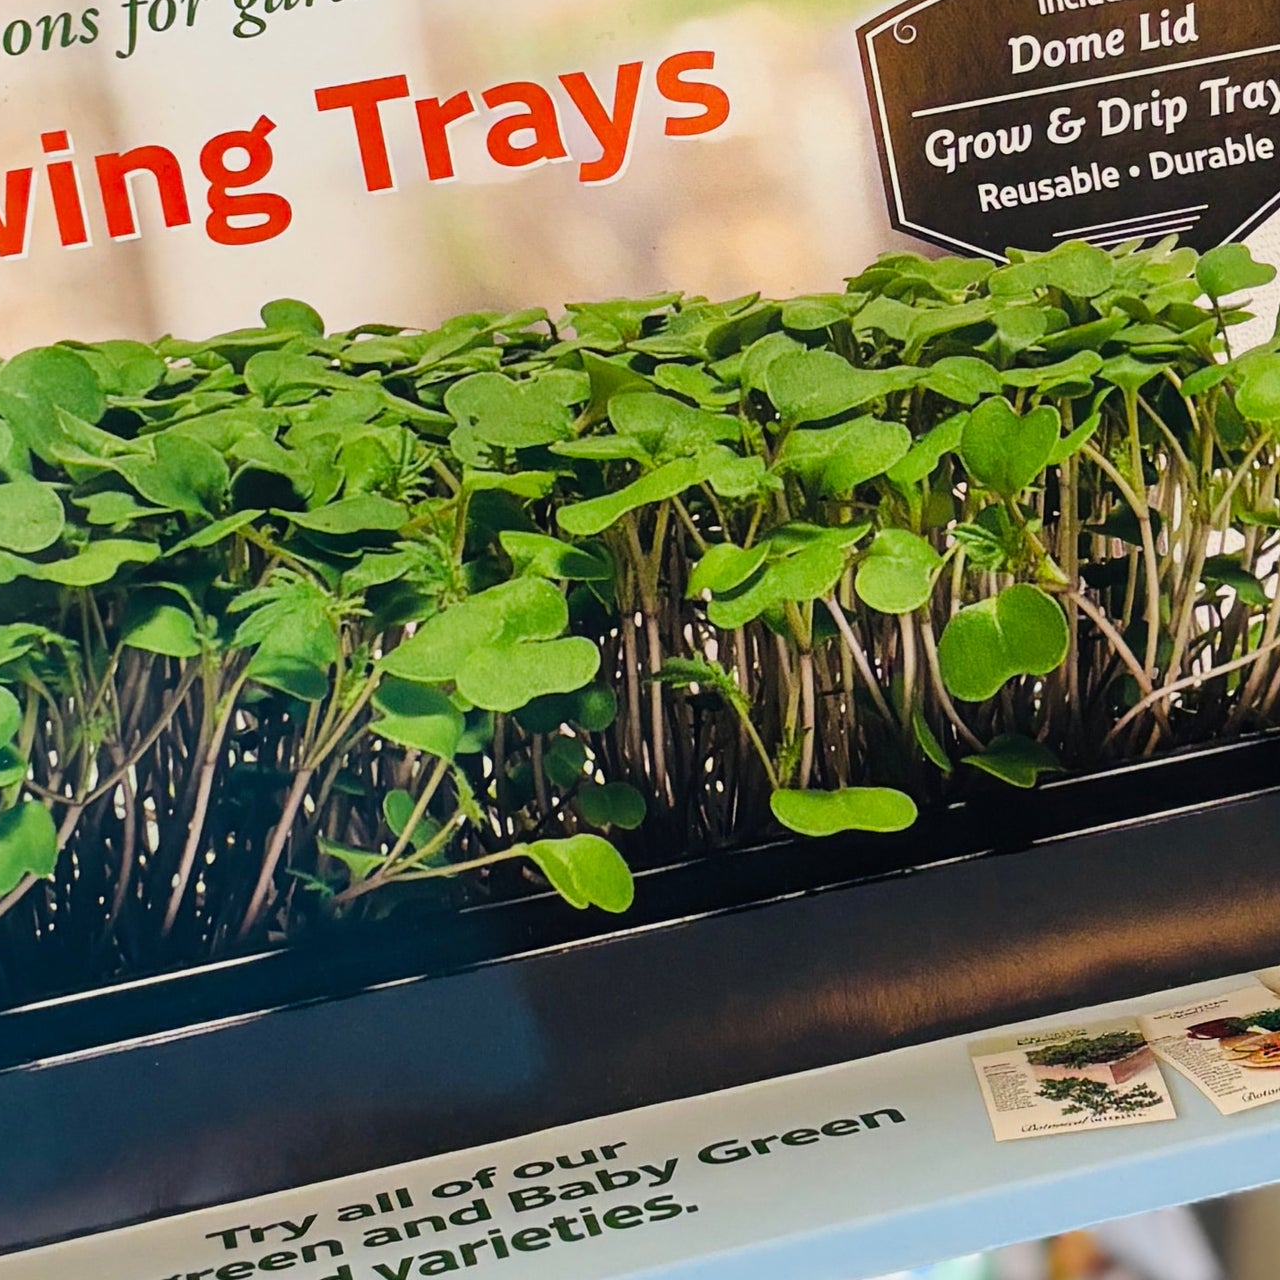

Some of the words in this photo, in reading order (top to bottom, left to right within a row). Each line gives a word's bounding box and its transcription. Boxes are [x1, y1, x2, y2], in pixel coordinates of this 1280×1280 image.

[1008, 27, 1126, 74] Dome
[1139, 3, 1199, 51] Lid
[314, 49, 731, 192] Trays
[924, 123, 1033, 174] Grow
[1047, 107, 1087, 144] &
[1097, 89, 1188, 138] Drip
[978, 162, 1120, 213] Reusable
[1149, 133, 1275, 181] Durable
[205, 1214, 320, 1254] Try
[335, 1187, 414, 1225] all
[430, 1165, 503, 1200] of
[513, 1142, 629, 1181] our
[360, 1199, 492, 1249] and
[508, 1157, 682, 1214] Baby
[698, 1106, 906, 1166] Green
